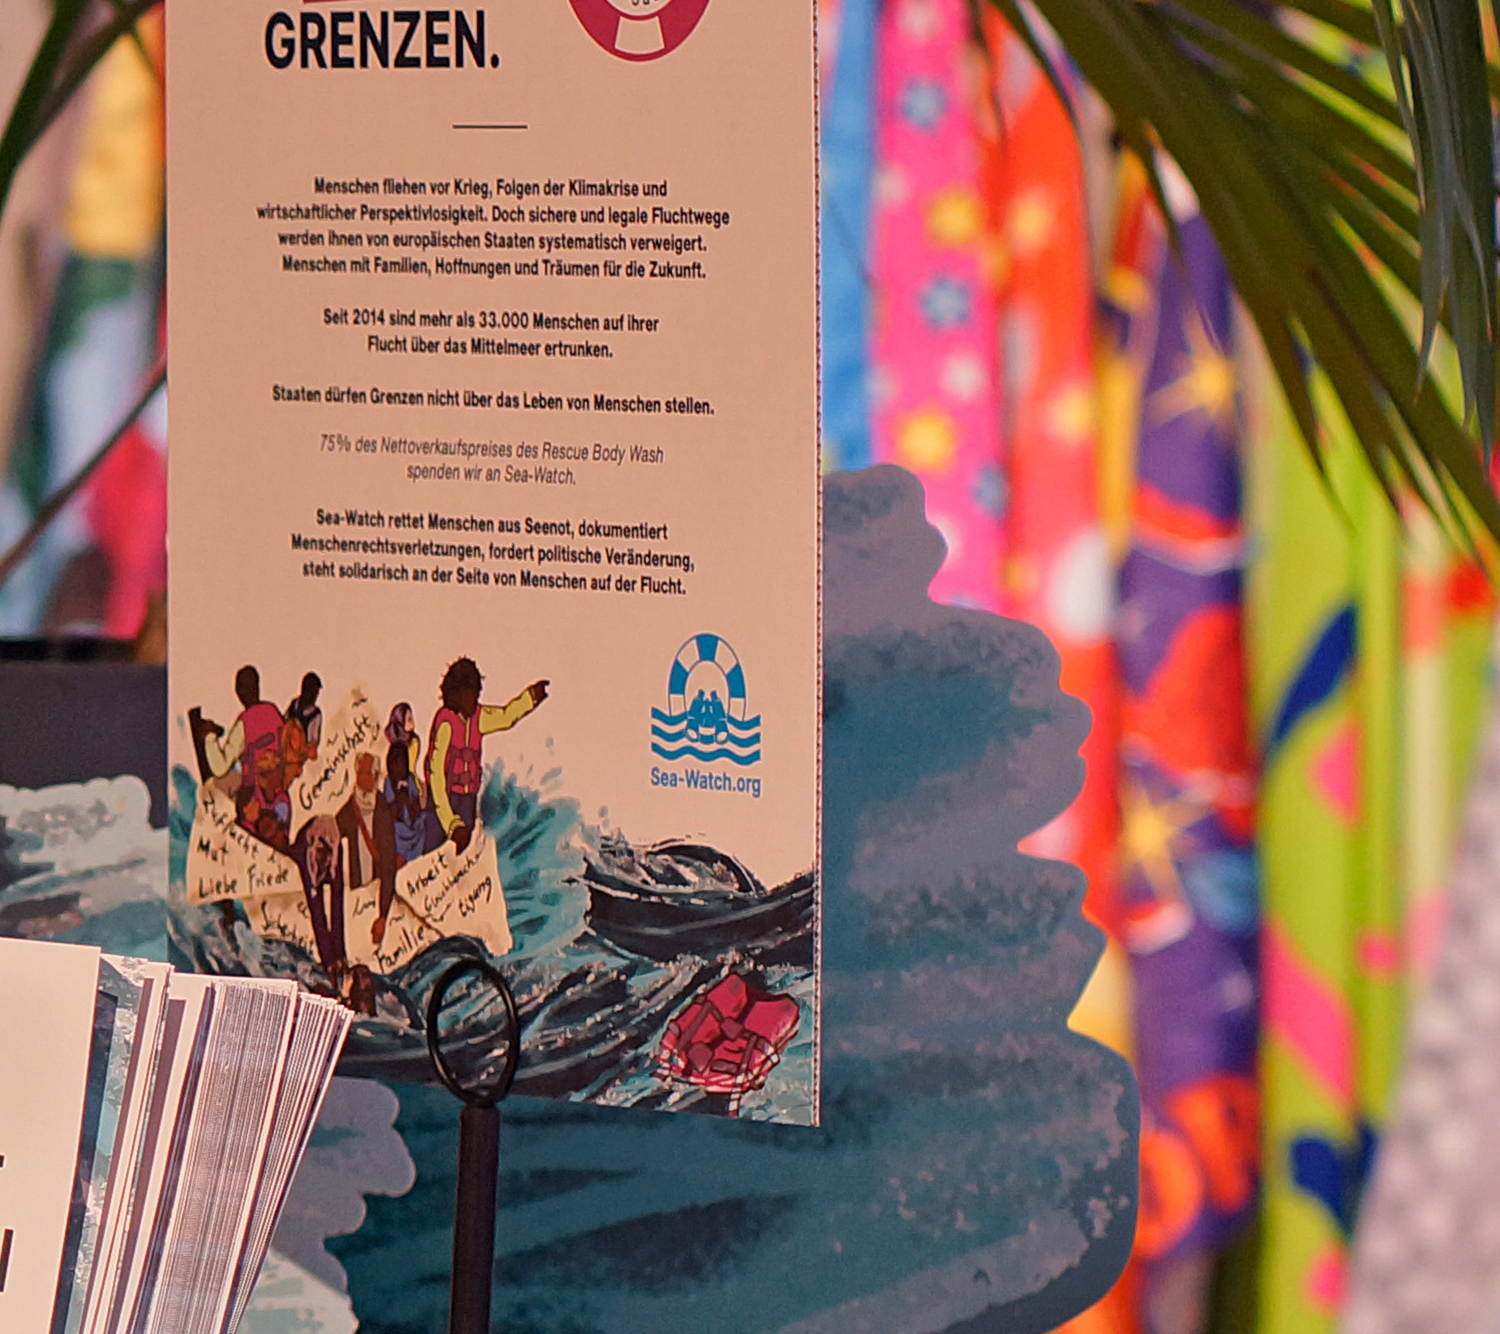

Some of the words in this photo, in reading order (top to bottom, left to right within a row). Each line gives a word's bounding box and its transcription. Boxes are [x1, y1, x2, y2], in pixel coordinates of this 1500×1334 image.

[264, 10, 500, 69] GRENZEN.
[314, 176, 380, 195] Menschen
[382, 177, 427, 196] fliehen
[429, 181, 451, 196] vor
[453, 177, 493, 200] Krieg,
[496, 178, 541, 201] Folgen
[543, 178, 566, 197] der
[568, 178, 640, 197] Klimakrise
[642, 179, 668, 197] und
[491, 204, 526, 223] Doch
[528, 205, 578, 224] sichere
[580, 206, 605, 224] und
[608, 206, 649, 228] legale
[651, 206, 730, 230] Fluchtwege
[277, 228, 325, 246] werden
[327, 229, 364, 247] ihnen
[365, 233, 390, 248] von
[392, 230, 481, 252] europäischen
[483, 231, 536, 250] Staaten
[538, 232, 627, 254] systematisch
[629, 233, 708, 256] verweigert.
[282, 254, 347, 273] Menschen
[349, 256, 371, 274] mit
[373, 255, 432, 277] Familien,
[435, 256, 512, 280] Hoffnungen
[514, 258, 539, 276] und
[541, 258, 600, 277] Träumen
[602, 259, 623, 277] für
[625, 260, 646, 278] die
[648, 260, 707, 279] Zukunft.
[323, 307, 349, 326] Seit
[352, 307, 386, 326] 2014
[388, 309, 417, 327] sind
[419, 309, 454, 328] mehr
[455, 310, 476, 329] als
[478, 310, 530, 330] 33.000
[532, 311, 600, 331] Menschen
[602, 313, 625, 331] auf
[627, 314, 660, 333] ihrer
[367, 334, 408, 353] Flucht
[410, 335, 441, 354] über
[443, 336, 468, 355] das
[470, 337, 542, 357] Mittelmeer
[544, 339, 614, 358] ertrunken.
[272, 384, 322, 403] Staaten
[324, 386, 367, 404] dürfen
[369, 386, 425, 406] Grenzen
[426, 389, 460, 407] nicht
[462, 390, 494, 408] über
[495, 391, 520, 409] das
[522, 391, 564, 410] Leben
[566, 397, 591, 411] von
[593, 393, 662, 413] Menschen
[664, 396, 715, 415] stellen.
[354, 435, 379, 454] des
[515, 440, 540, 460] des
[541, 441, 590, 462] Rescue
[591, 443, 626, 467] Body
[627, 444, 665, 464] Wash
[405, 462, 461, 484] spenden
[462, 463, 482, 481] wir
[484, 467, 502, 482] an
[503, 464, 578, 486] Sea-Watch.
[316, 507, 386, 528] Sea-Watch
[388, 512, 425, 530] rettet
[427, 512, 495, 533] Menschen
[497, 519, 522, 534] aus
[524, 516, 575, 540] Seenot,
[578, 519, 668, 540] dokumentiert
[488, 541, 535, 561] fordert
[537, 544, 602, 566] politische
[604, 546, 695, 573] Veränderung,
[302, 560, 336, 578] steht
[338, 561, 409, 581] solidarisch
[411, 568, 428, 582] an
[430, 565, 454, 584] der
[456, 566, 490, 586] Seite
[492, 572, 517, 587] von
[519, 569, 588, 590] Menschen
[590, 574, 612, 591] auf
[614, 574, 638, 593] der
[640, 575, 687, 595] Flucht.
[651, 767, 761, 798] Sea-Watch.org
[197, 835, 229, 866] Mut
[200, 873, 238, 899] Liebe
[247, 864, 289, 894] Friede
[406, 852, 449, 897] Arbeit
